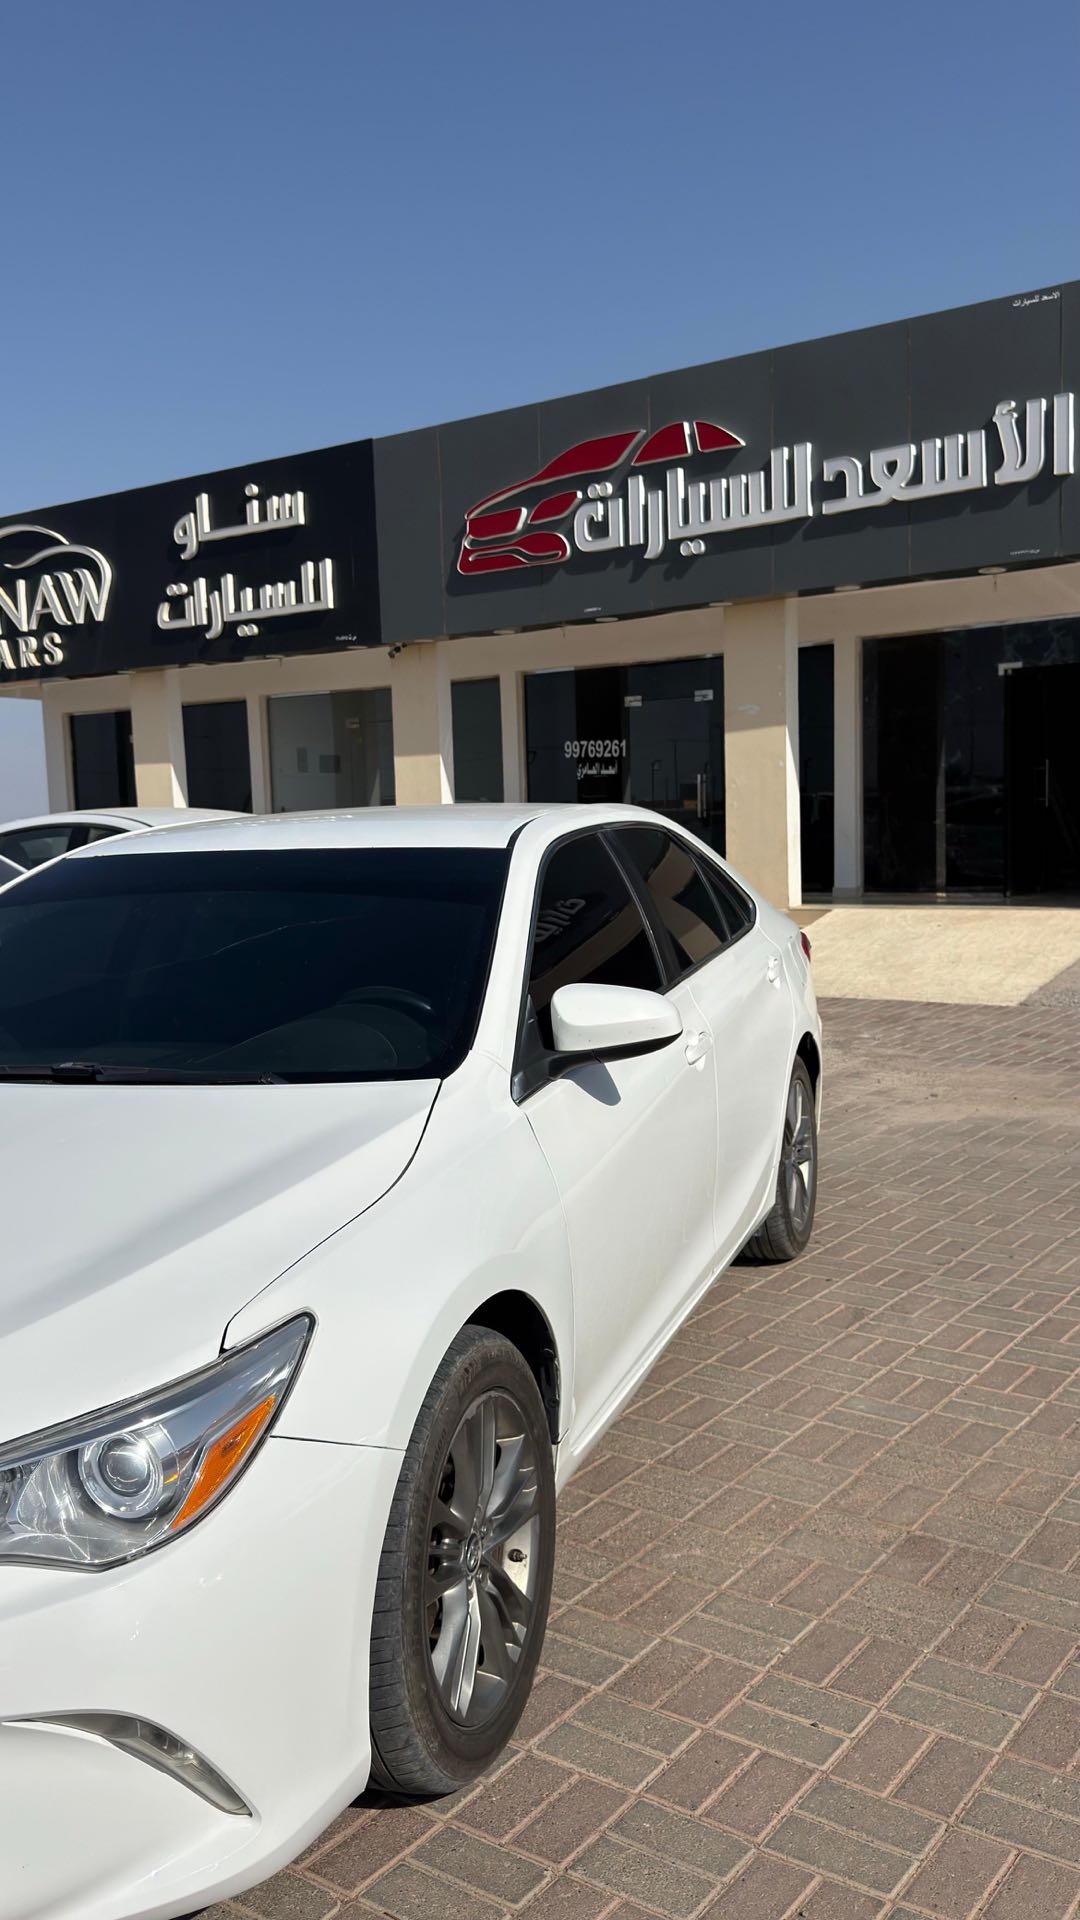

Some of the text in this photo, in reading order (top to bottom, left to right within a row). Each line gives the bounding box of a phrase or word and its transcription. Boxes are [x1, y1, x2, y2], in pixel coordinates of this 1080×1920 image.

[574, 392, 1075, 559] الأسعد للسيارات
[173, 483, 305, 560] سناو
[157, 557, 335, 639] للسيارات
[564, 739, 627, 758] 99769261
